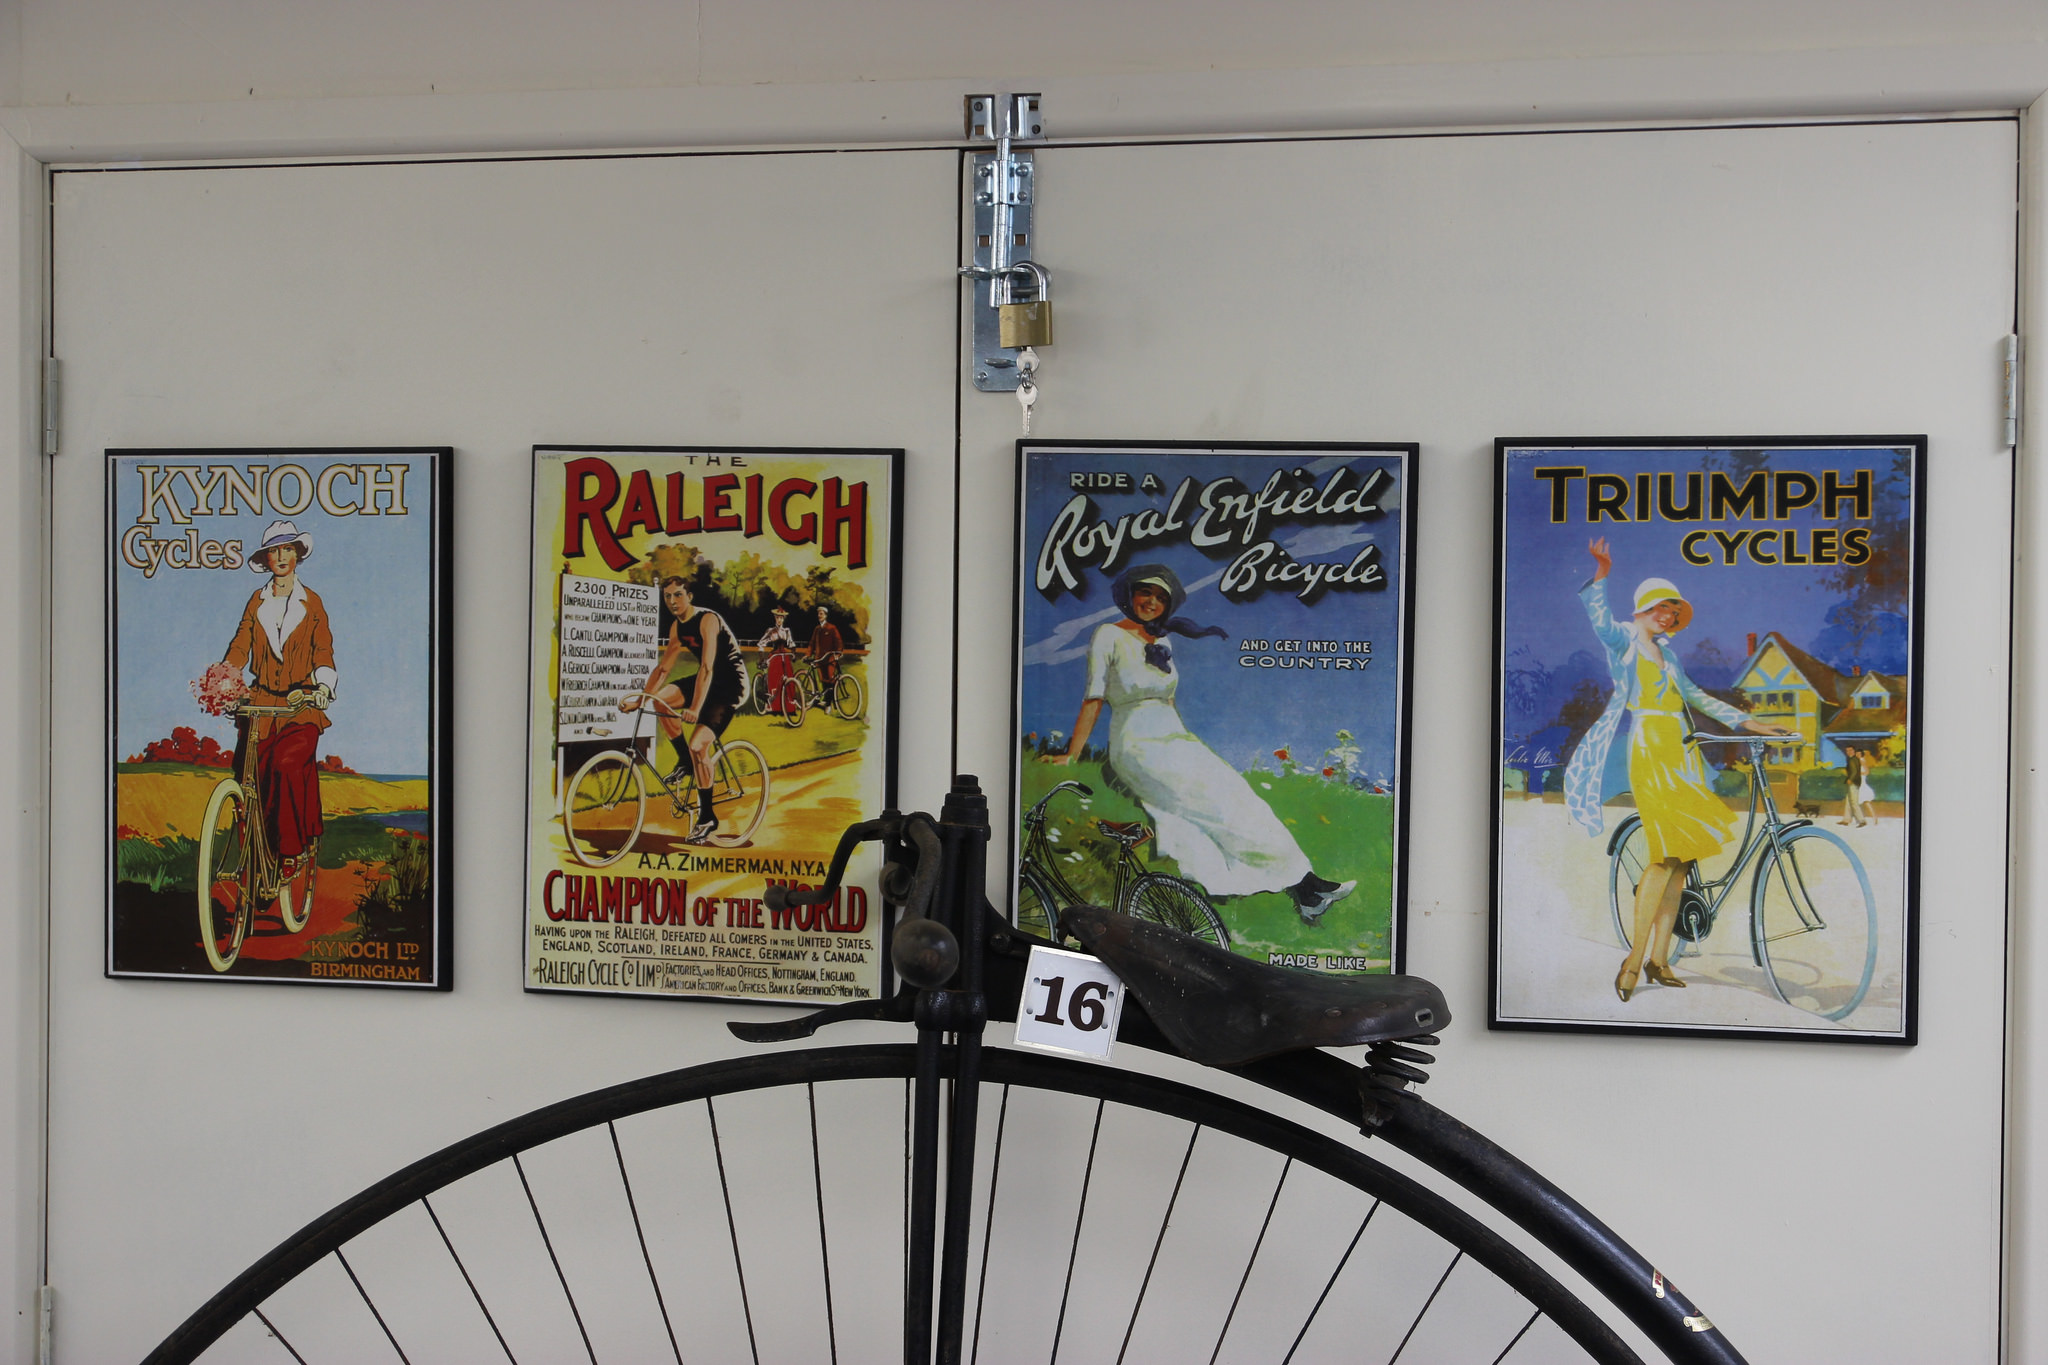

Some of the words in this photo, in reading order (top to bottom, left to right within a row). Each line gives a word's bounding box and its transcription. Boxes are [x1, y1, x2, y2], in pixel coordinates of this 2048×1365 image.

[684, 455, 748, 467] THE
[1070, 471, 1129, 490] RIDE
[1141, 473, 1158, 489] A
[137, 464, 409, 524] KYNOCH
[1533, 465, 1874, 524] TRIUMPH
[562, 457, 867, 572] RALEIGH
[1035, 477, 1192, 591] Royal
[1191, 467, 1386, 547] Enfield
[122, 525, 243, 578] Cycles
[1680, 528, 1872, 567] CYCLES
[1218, 541, 1384, 599] Bicycle
[612, 584, 649, 600] PRIZES
[563, 594, 614, 610] UNPARALLELED
[616, 602, 631, 612] LIST
[636, 602, 658, 614] RIDERS
[627, 615, 640, 626] ONE
[640, 616, 657, 627] YEAR
[594, 629, 628, 643] CHAMPION
[596, 645, 624, 658] CHAMPION
[1239, 639, 1270, 653] AND
[1274, 640, 1302, 653] GET
[1306, 640, 1338, 654] INTO
[1343, 640, 1371, 654] THE
[591, 662, 620, 675] CHAMPION
[1238, 655, 1373, 671] COUNTRY
[543, 869, 687, 926] CHAMPION
[693, 896, 720, 926] OF
[724, 897, 765, 929] THE
[765, 878, 867, 933] WORLD
[534, 925, 566, 938] HAVING
[570, 929, 592, 939] UPON
[595, 930, 610, 939] THE
[661, 929, 706, 943] DEFEATED
[709, 933, 726, 944] ALL
[729, 932, 767, 945] COMERS
[769, 938, 778, 946] IN
[781, 939, 795, 947] THE
[797, 936, 832, 948] UNITED
[311, 941, 389, 959] KYNOCH
[542, 938, 593, 954] ENGLAND,
[597, 940, 656, 956] SCOTLAND,
[661, 944, 708, 958] IRELAND,
[712, 945, 756, 960] FRANCE,
[759, 947, 808, 961] GERMANY
[811, 951, 819, 961] &
[823, 950, 868, 964] CANADA.
[311, 962, 420, 981] BIRMINGHAM
[539, 957, 585, 985] RALEIGH
[587, 959, 619, 986] CYCLE
[716, 964, 736, 977] HEAD
[1268, 953, 1318, 969] MADE
[1325, 955, 1366, 971] LIKE
[769, 982, 788, 994] BANK
[1034, 975, 1110, 1032] 16
